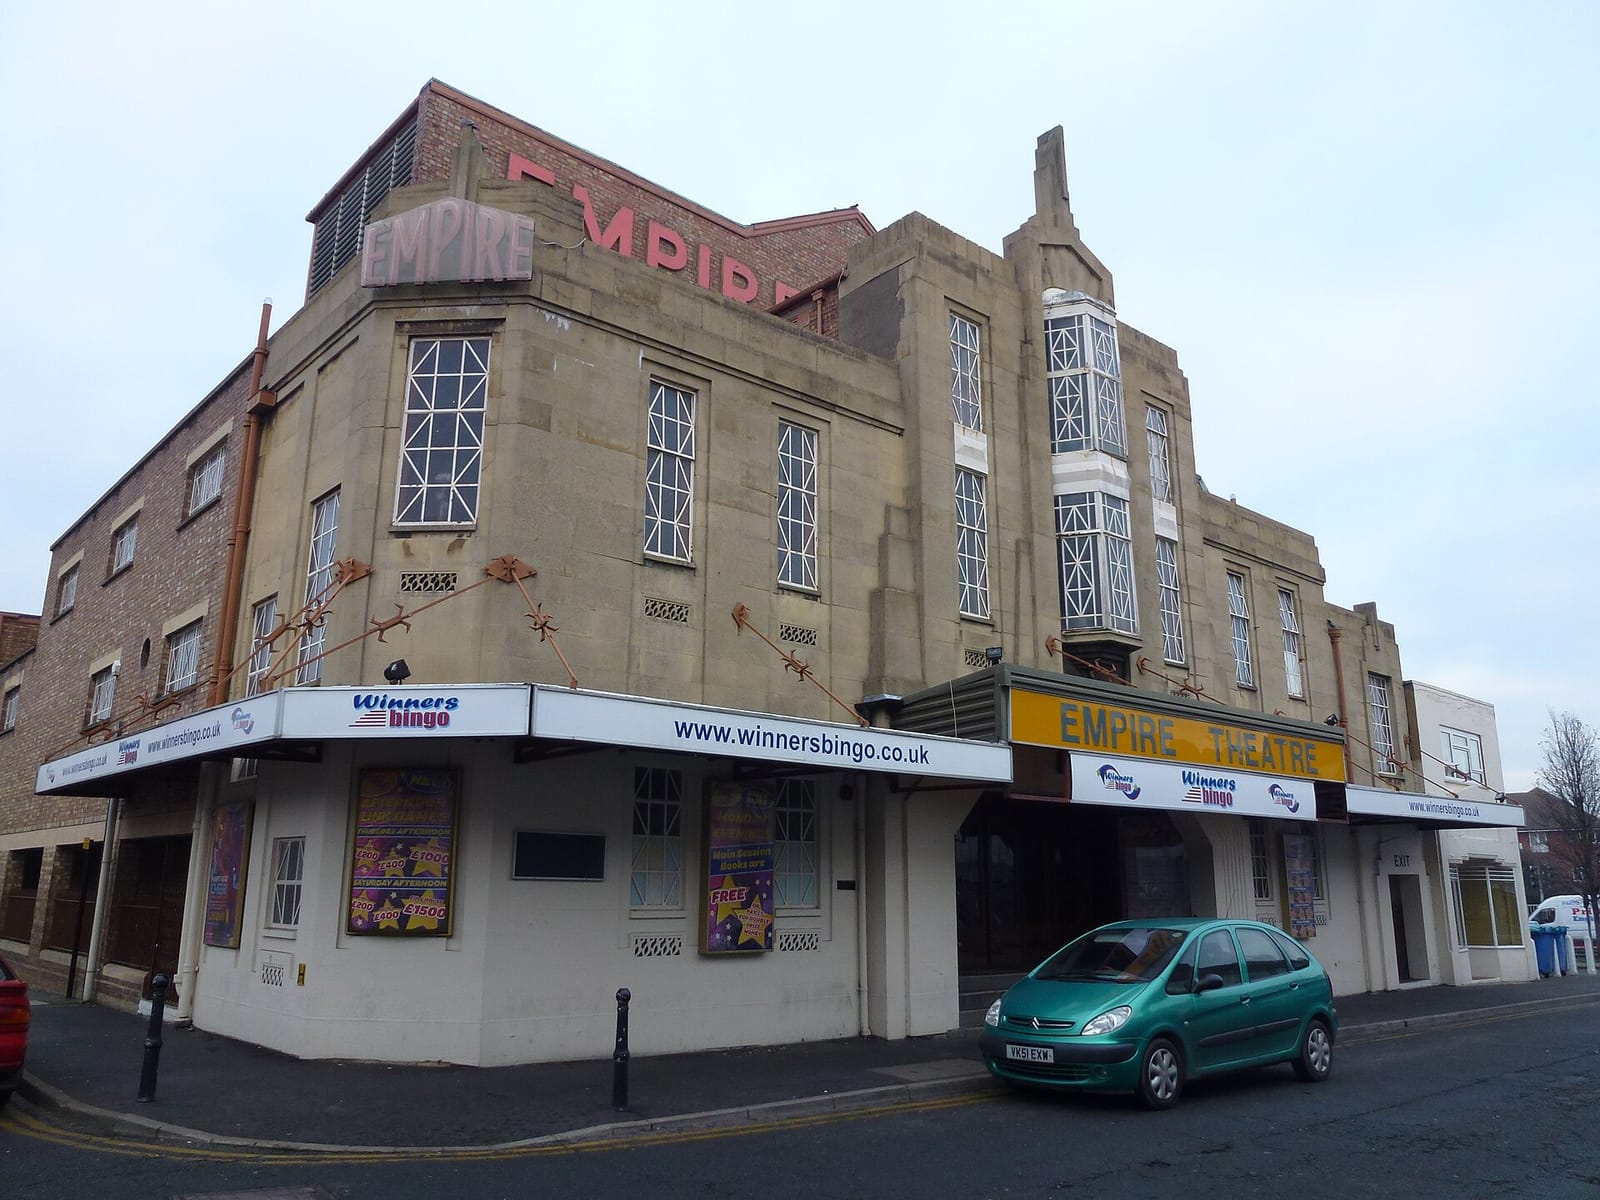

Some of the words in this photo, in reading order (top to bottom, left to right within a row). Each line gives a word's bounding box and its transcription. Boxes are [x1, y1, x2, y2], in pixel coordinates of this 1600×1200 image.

[361, 200, 534, 287] EMPIRE
[353, 694, 459, 710] Winners
[389, 709, 450, 728] bingo
[147, 721, 221, 753] www.winnersbingo.co.uk
[674, 720, 929, 765] www.winnersbingo.co.uk
[1060, 702, 1176, 756] EMPIRE
[1208, 726, 1318, 775] THEATRE
[1181, 769, 1236, 791] Winners
[1202, 787, 1233, 807] bingo
[1409, 800, 1480, 818] www.winnersbingo.co.uk
[357, 851, 378, 860] £200
[410, 850, 449, 864] £1000
[380, 860, 405, 870] £400
[1393, 855, 1410, 867] EXIT
[353, 879, 392, 887] SATURDAY
[393, 879, 447, 887] AFTERNOON
[711, 888, 746, 903] FREE
[352, 901, 373, 911] £200
[403, 903, 446, 918] £1500
[374, 911, 399, 921] £400
